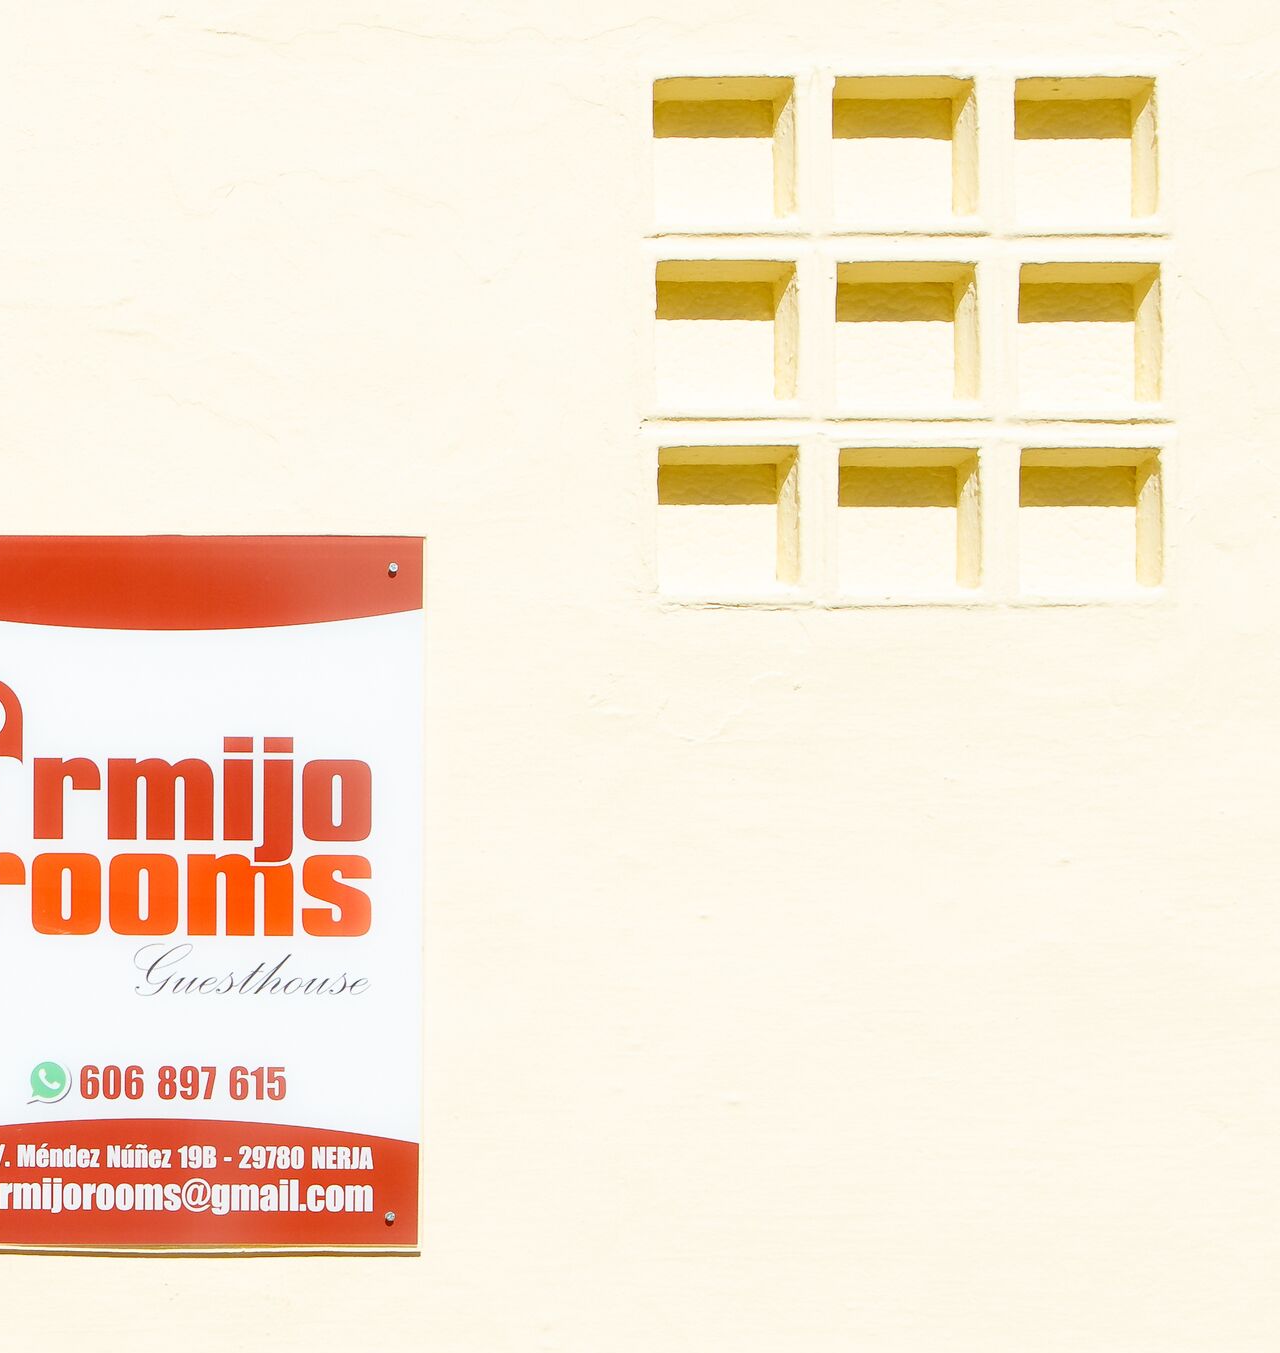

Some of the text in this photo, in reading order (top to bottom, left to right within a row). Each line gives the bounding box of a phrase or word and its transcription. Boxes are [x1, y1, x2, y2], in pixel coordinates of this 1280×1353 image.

[133, 943, 373, 997] Guesthouse
[79, 1065, 288, 1102] 606 897 615
[17, 1142, 102, 1170] Méndez
[106, 1143, 173, 1170] Núñez
[178, 1145, 218, 1171] 19B
[238, 1145, 306, 1171] 29780
[311, 1146, 375, 1171] NERJA
